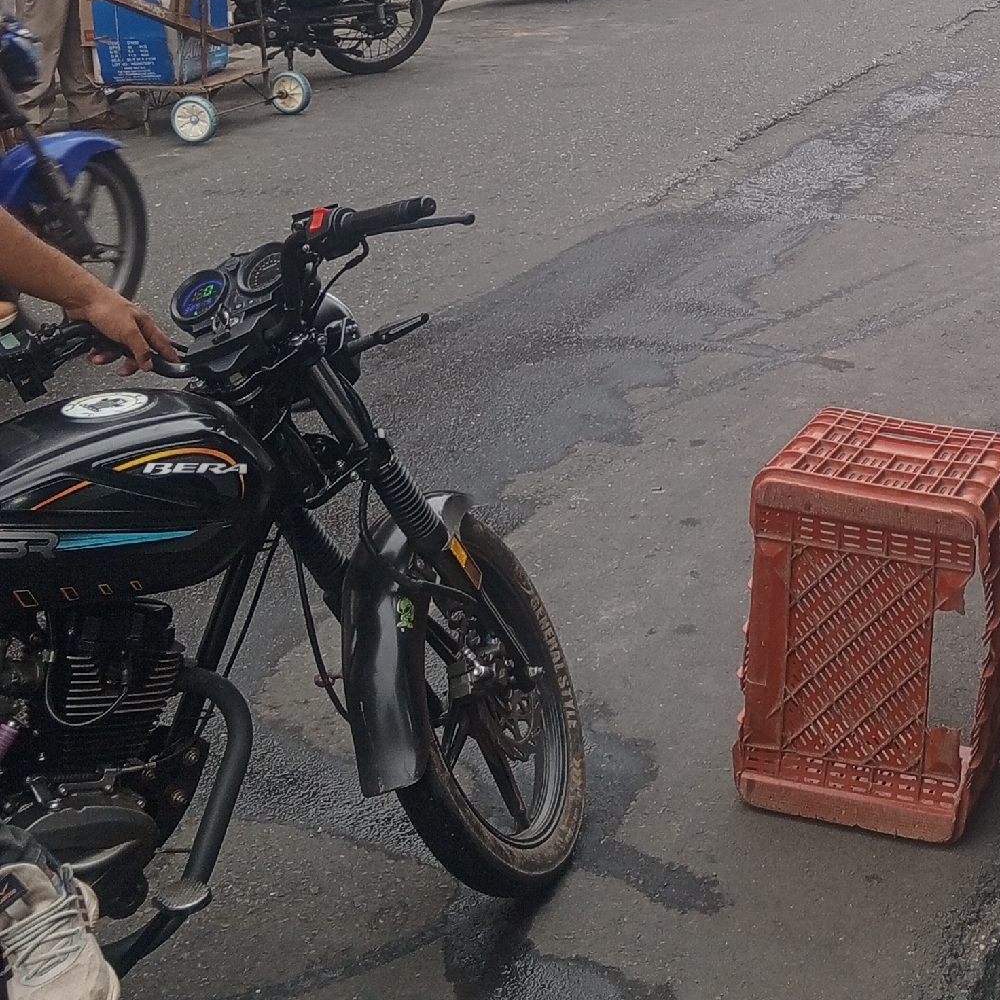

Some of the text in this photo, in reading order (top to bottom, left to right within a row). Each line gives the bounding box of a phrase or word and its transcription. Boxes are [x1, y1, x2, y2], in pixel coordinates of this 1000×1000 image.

[142, 462, 248, 475] BERA
[530, 598, 578, 729] GENERAL STYLE
